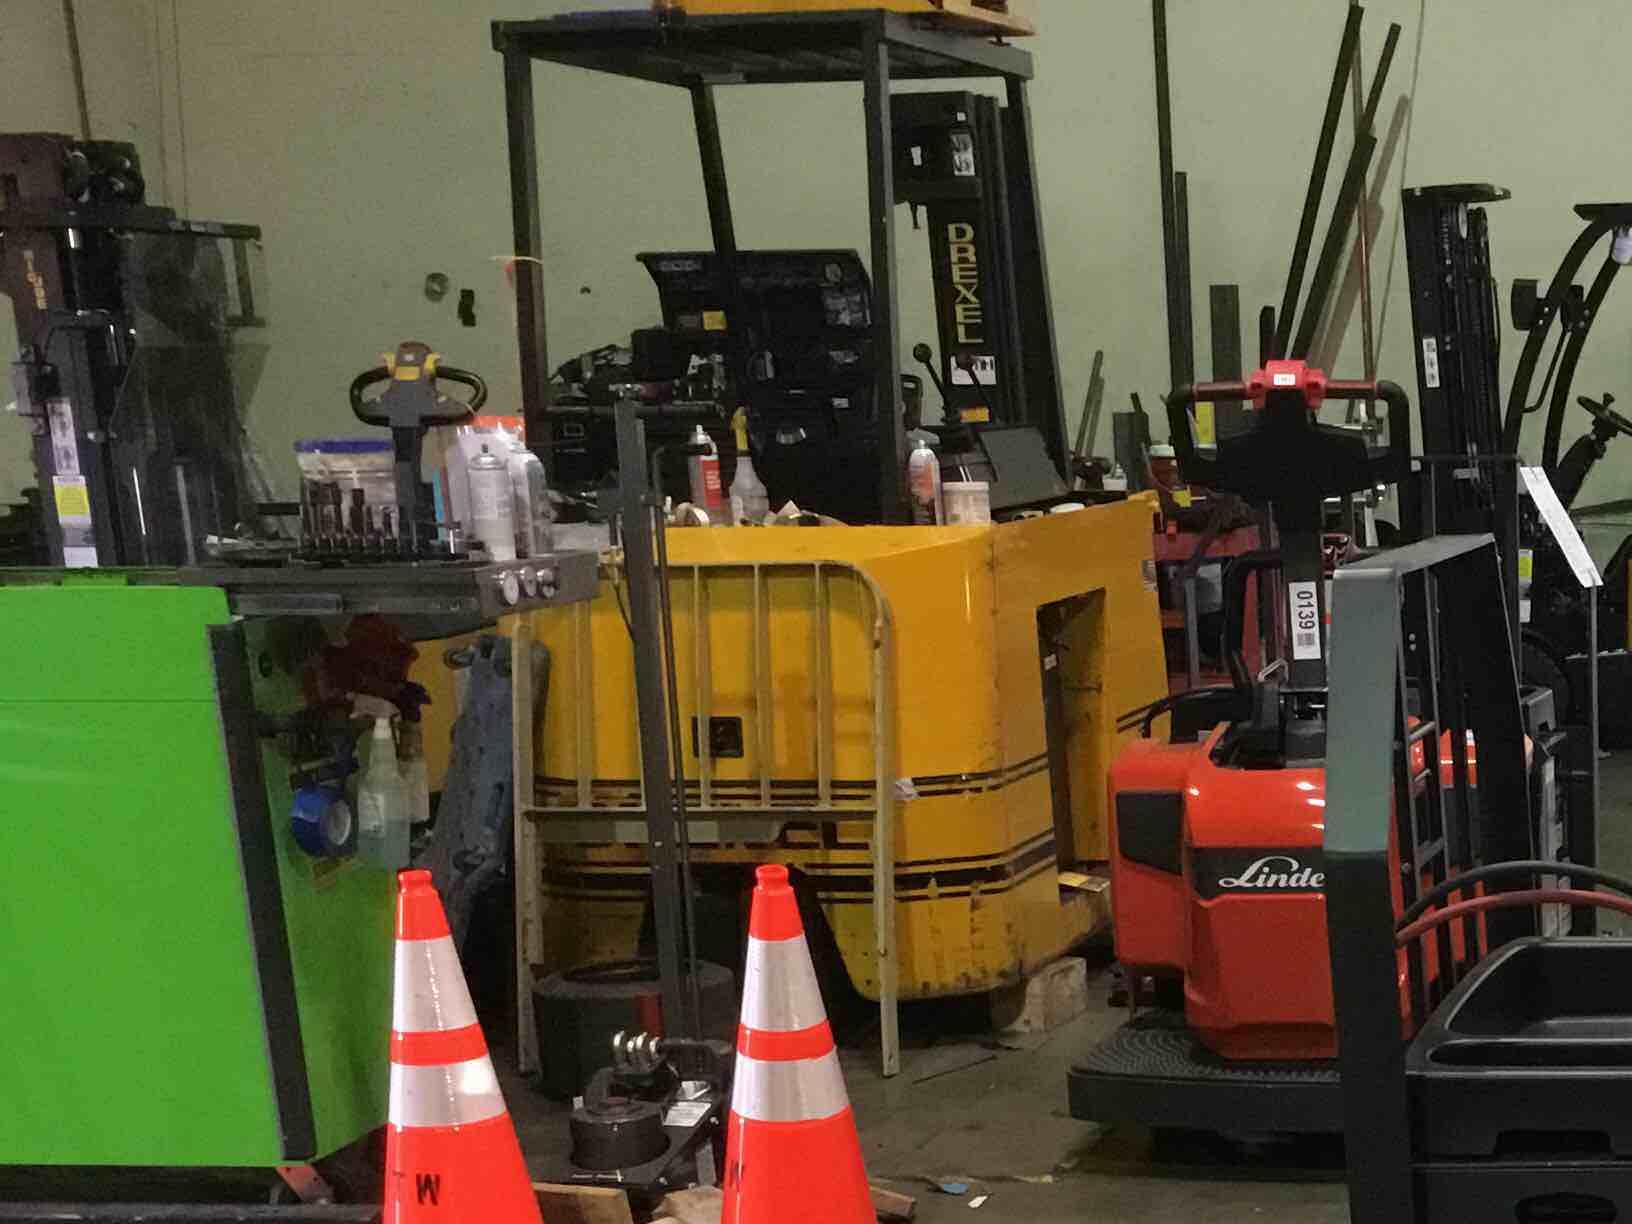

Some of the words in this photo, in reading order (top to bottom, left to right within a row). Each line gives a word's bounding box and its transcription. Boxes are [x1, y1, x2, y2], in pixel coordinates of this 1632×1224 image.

[948, 223, 984, 343] DREXEL
[1296, 590, 1315, 630] 0139
[1218, 855, 1325, 888] Linde
